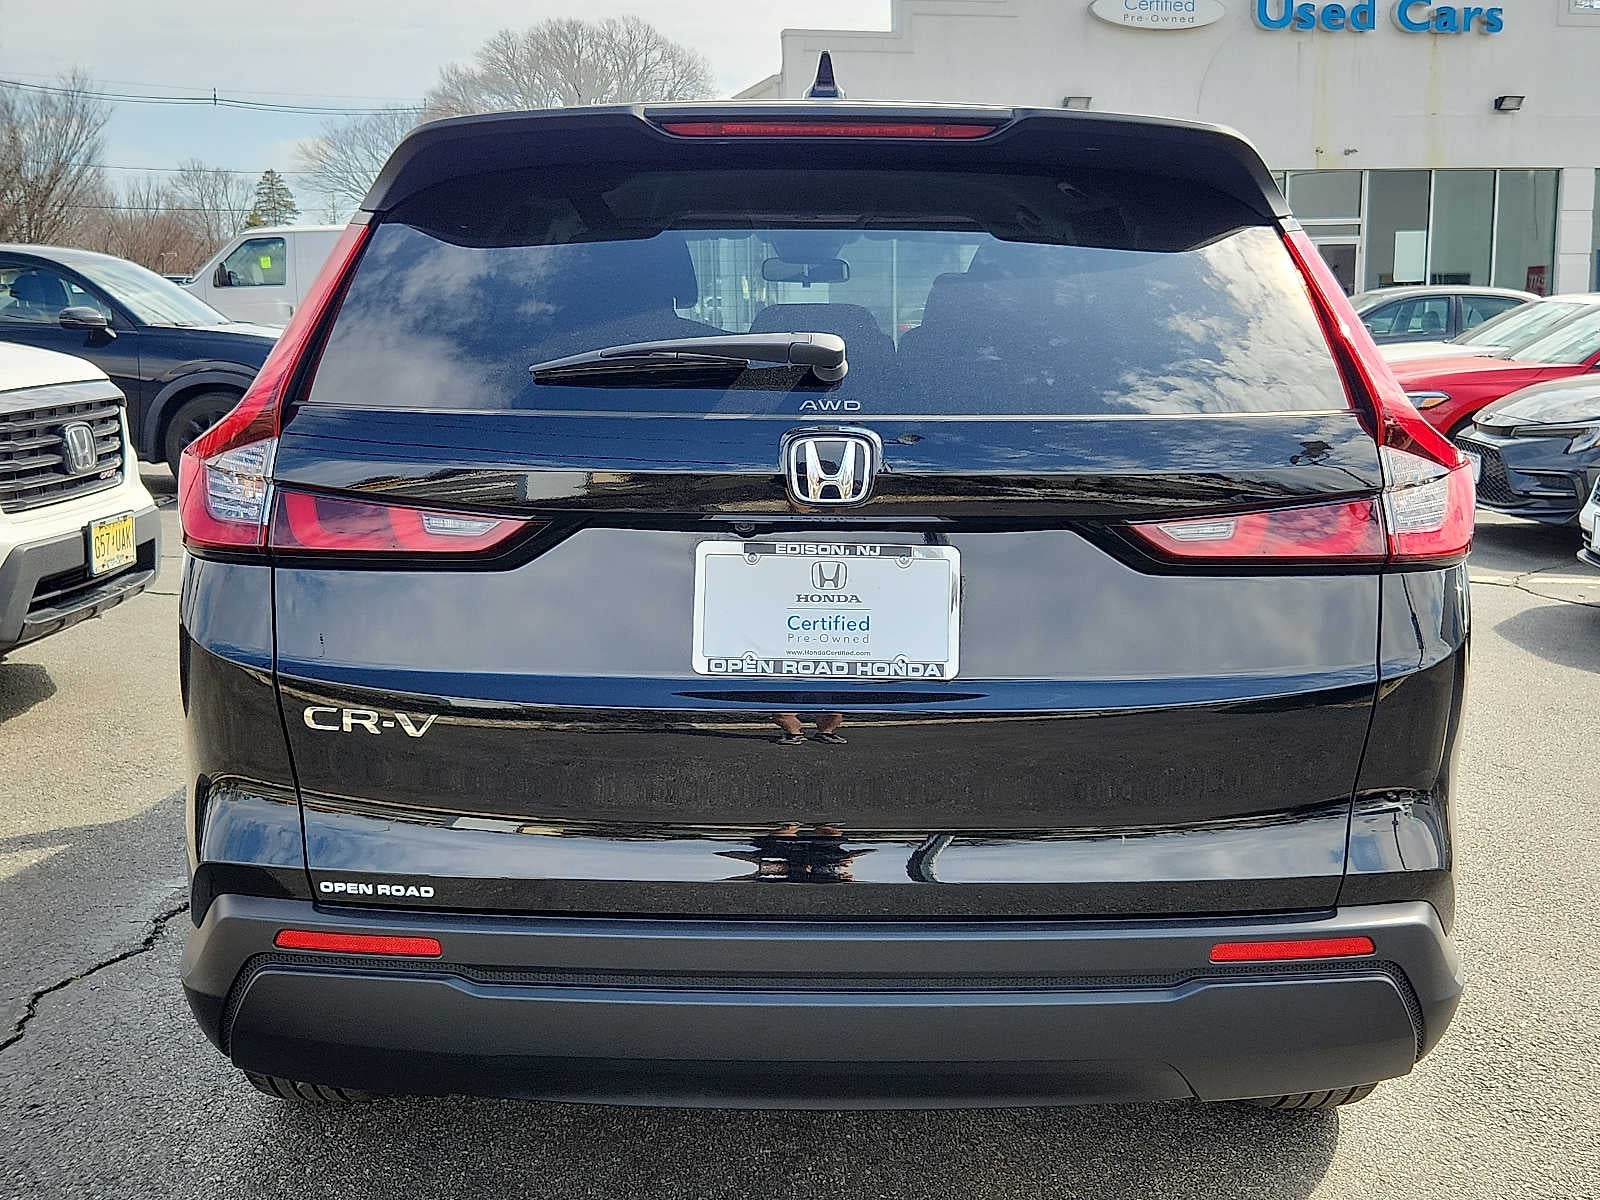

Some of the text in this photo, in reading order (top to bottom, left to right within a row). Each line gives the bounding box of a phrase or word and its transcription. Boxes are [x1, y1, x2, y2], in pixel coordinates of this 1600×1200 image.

[1124, 0, 1195, 12] Certified
[1255, 0, 1504, 33] Used Cars
[799, 399, 861, 411] AWD
[775, 543, 881, 556] EDISON, NJ
[795, 593, 862, 603] HONDA
[787, 615, 870, 632] Certified
[787, 633, 869, 644] Pre-Owned
[709, 658, 945, 678] OPEN ROAD HONDA
[303, 706, 439, 738] CR-V
[319, 881, 434, 898] OPEN ROAD
